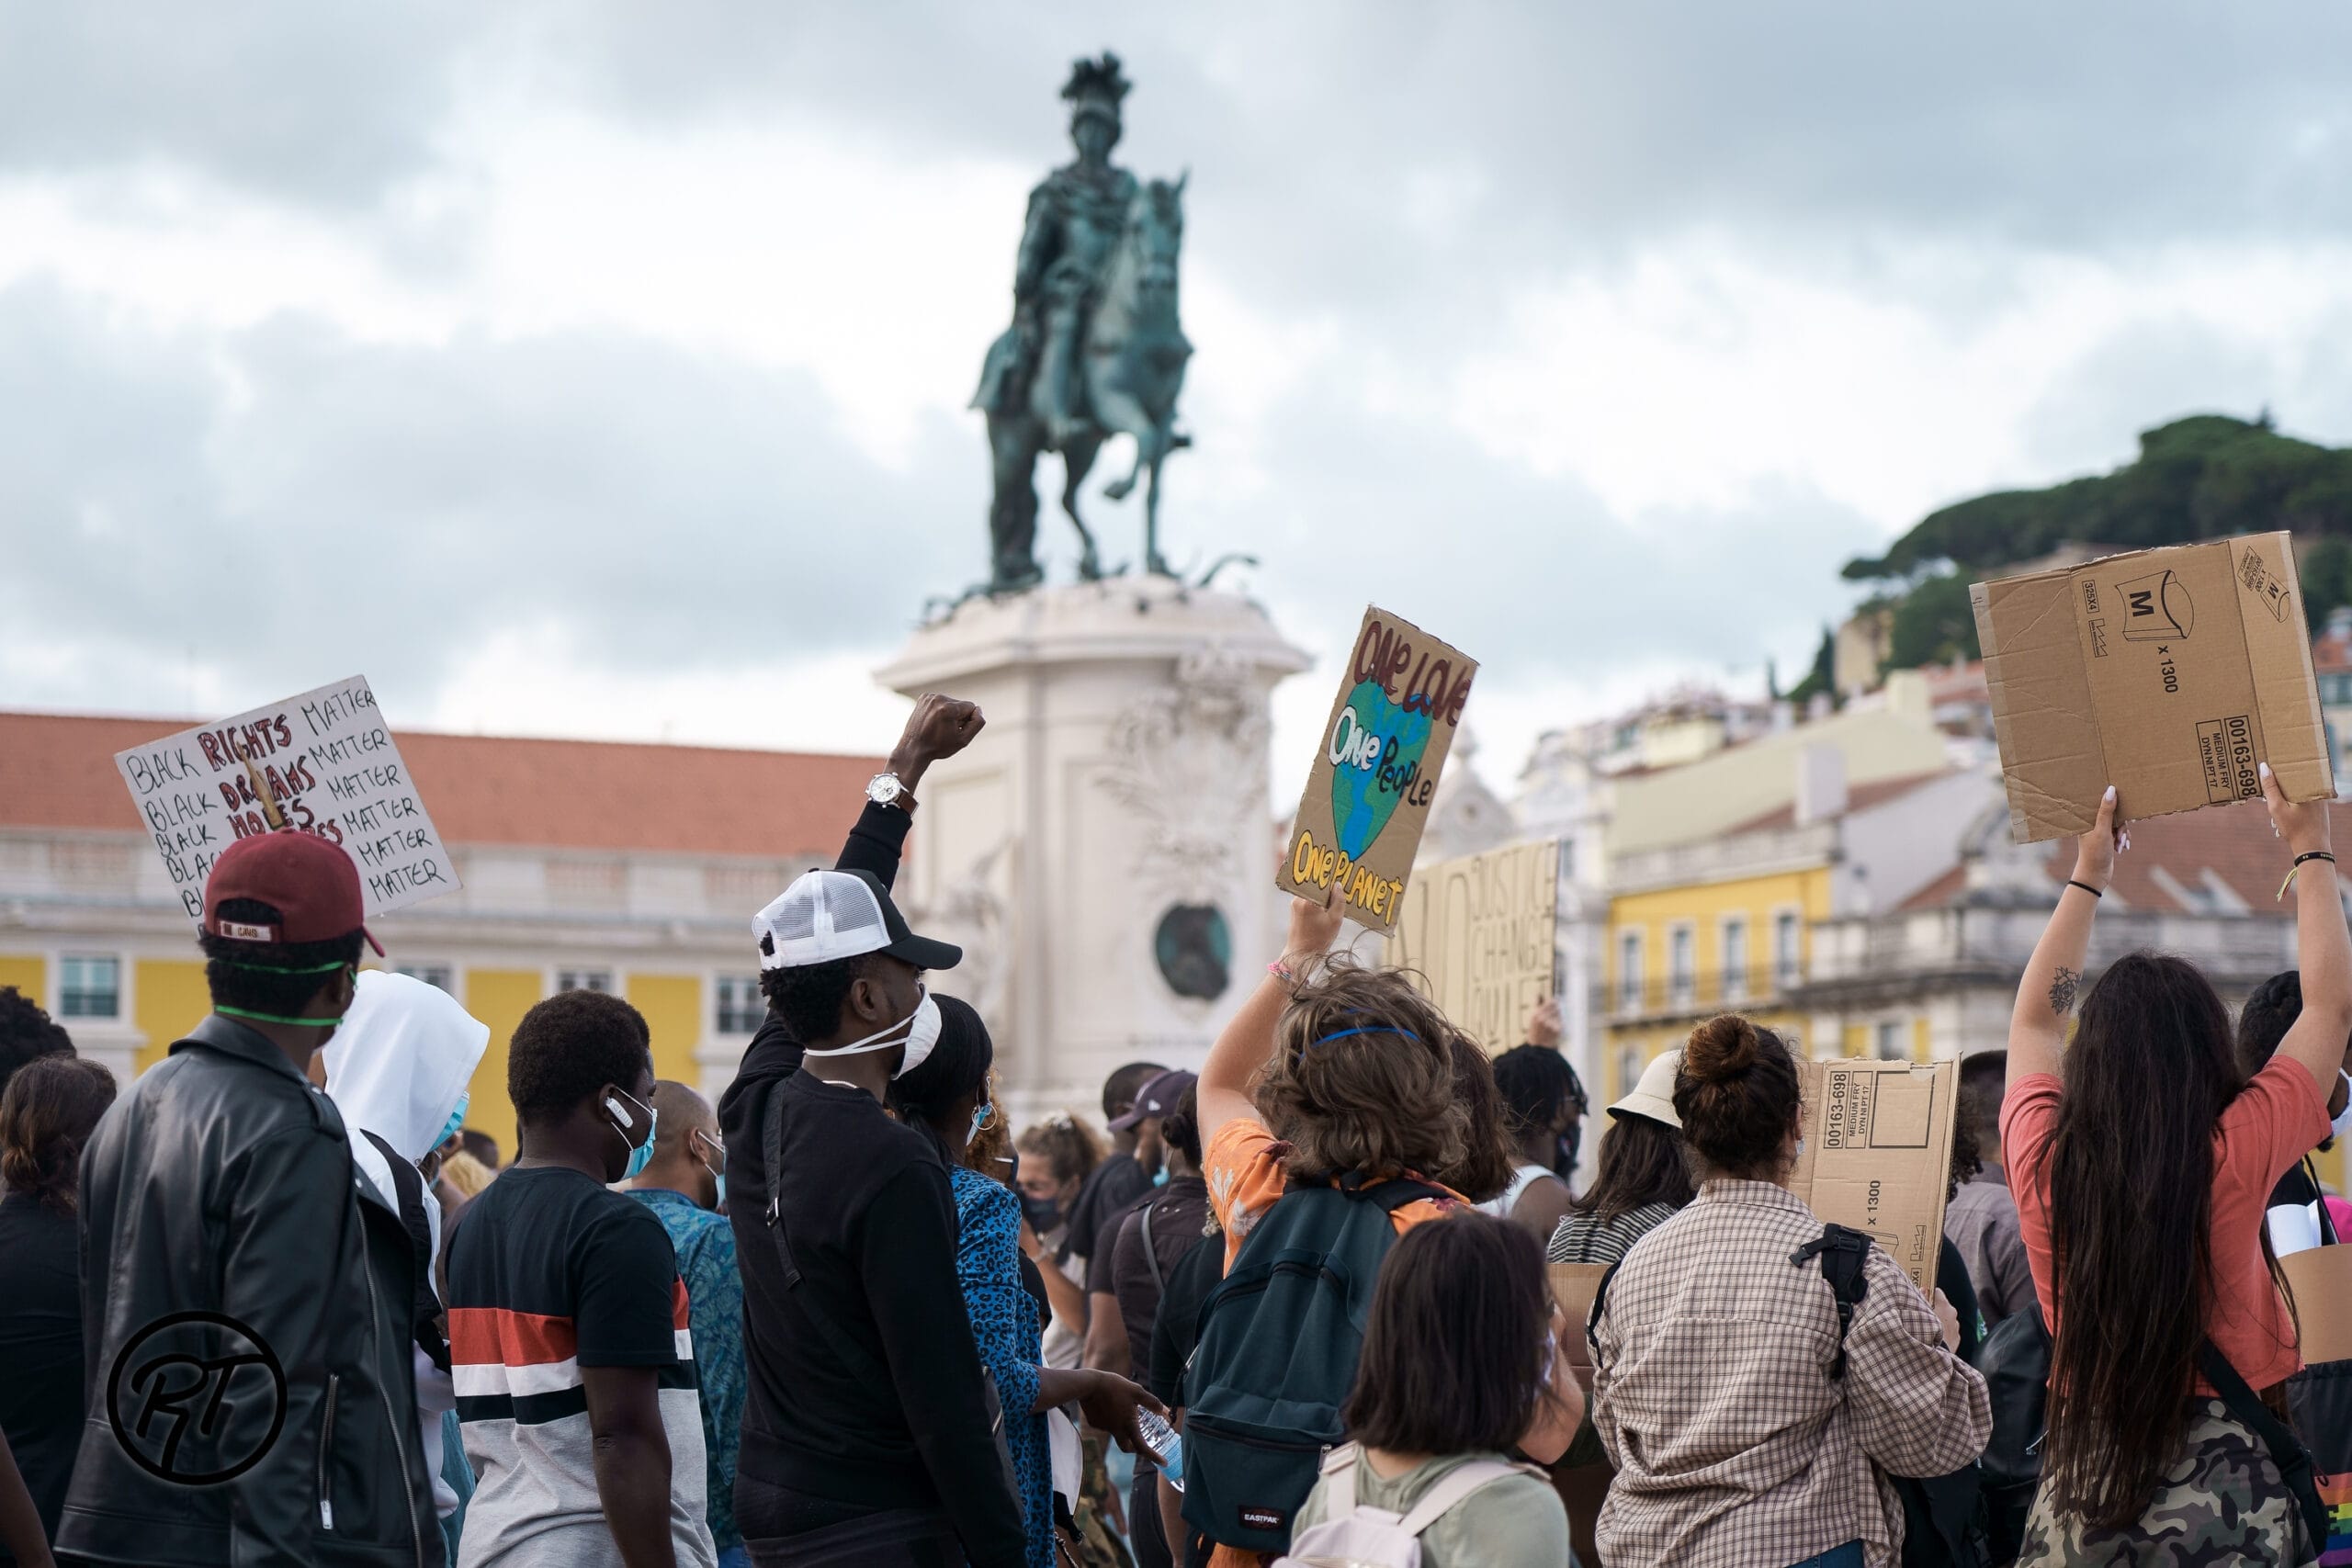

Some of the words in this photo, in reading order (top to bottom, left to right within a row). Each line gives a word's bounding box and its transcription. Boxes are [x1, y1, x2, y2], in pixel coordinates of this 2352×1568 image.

[2084, 581, 2098, 612] 325X4
[2129, 590, 2155, 618] M
[2267, 581, 2279, 600] M
[2160, 658, 2179, 694] 1300
[126, 748, 201, 795] BLACK
[197, 713, 292, 773] RIGHTS
[301, 689, 377, 737] MATTER
[2201, 738, 2211, 756] DYN
[2229, 719, 2257, 796] 00163-698
[2207, 766, 2217, 777] PT
[2212, 732, 2227, 770] MEDIUM
[2220, 771, 2231, 789] FRY
[144, 792, 218, 833] BLACK
[308, 728, 388, 770] MATTER
[2209, 778, 2218, 788] 17
[155, 824, 218, 859] BLACK
[326, 764, 401, 802] MATTER
[166, 851, 223, 884] BLAC
[342, 797, 419, 836] MATTER
[356, 828, 433, 867] MATTER
[368, 858, 447, 903] MATTER
[1862, 1096, 1869, 1105] PT
[1863, 1086, 1870, 1094] 17
[1827, 1073, 1847, 1147] 00163-698
[1849, 1102, 1859, 1137] MEDIUM
[1867, 1179, 1881, 1213] 1300
[1244, 1514, 1279, 1524] EASTPAK
